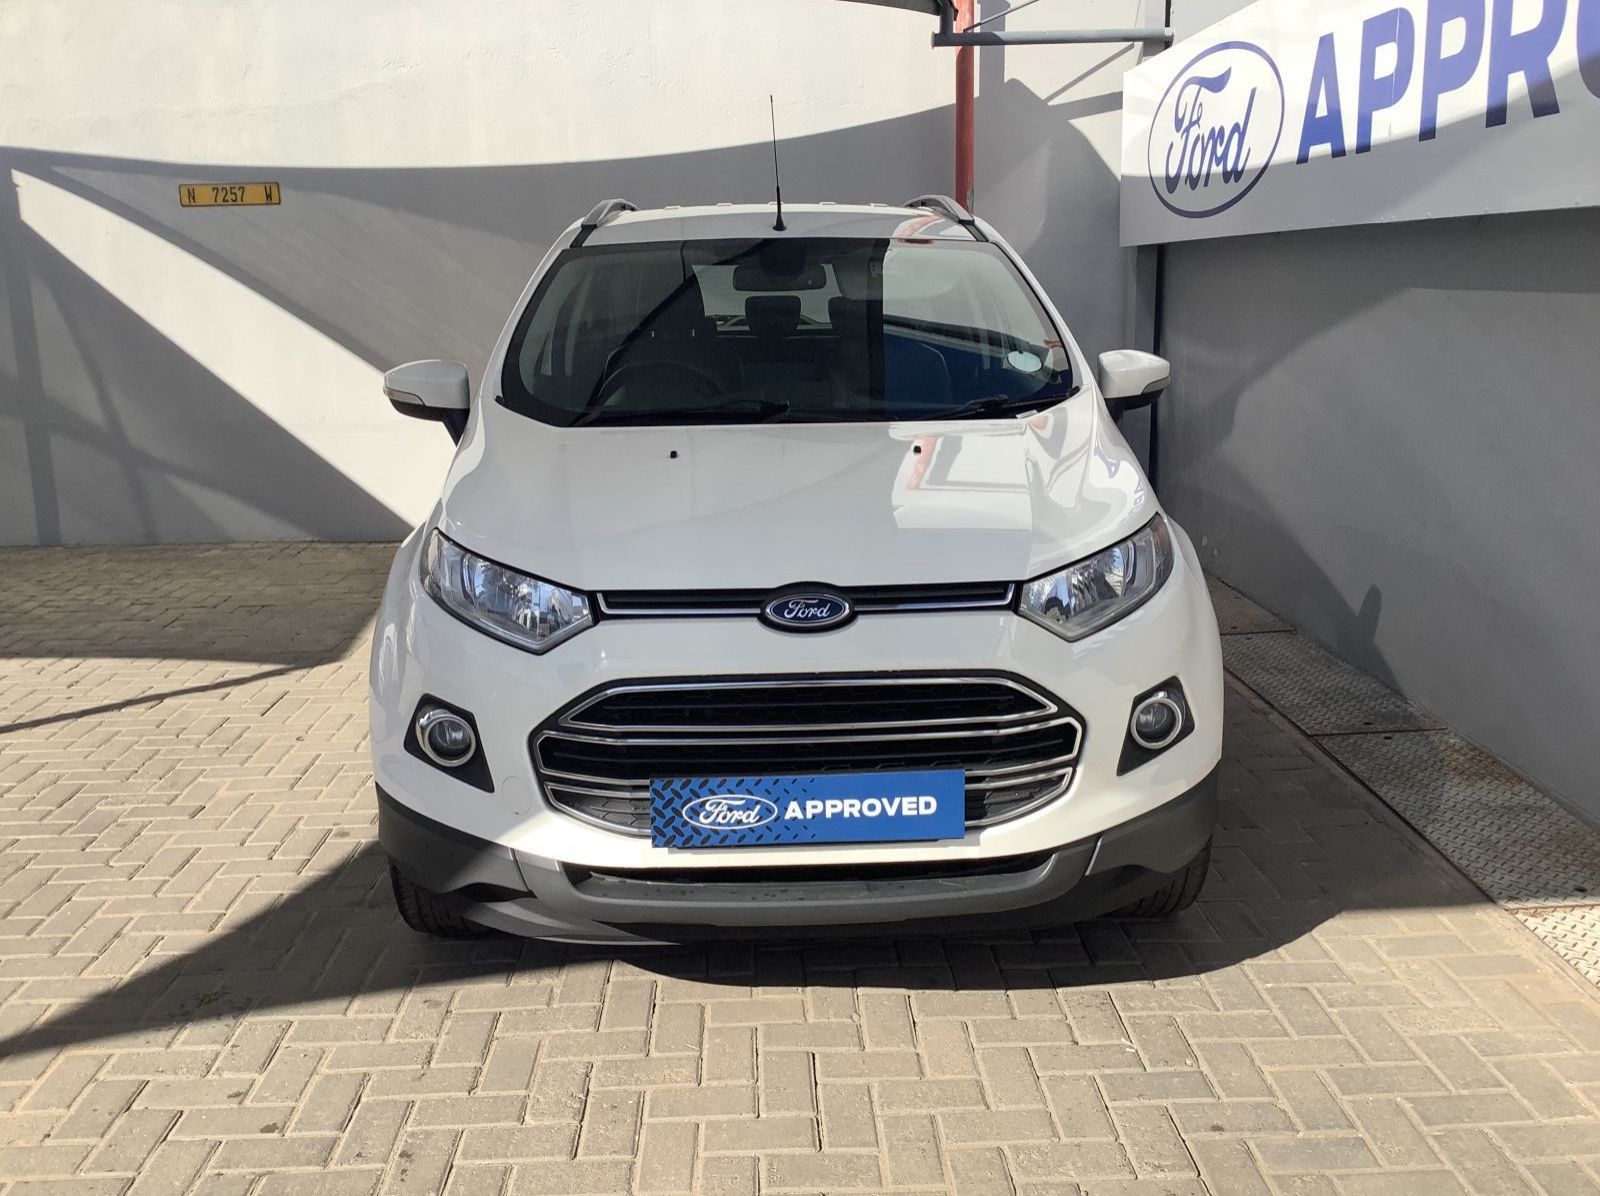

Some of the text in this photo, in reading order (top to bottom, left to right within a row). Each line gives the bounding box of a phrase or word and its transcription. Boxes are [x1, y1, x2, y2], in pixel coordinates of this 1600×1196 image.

[1165, 0, 1600, 194] Ford APPR
[187, 187, 196, 203] N
[212, 186, 246, 203] 7257
[784, 599, 831, 618] Ford
[699, 796, 937, 824] Ford APPROVED
